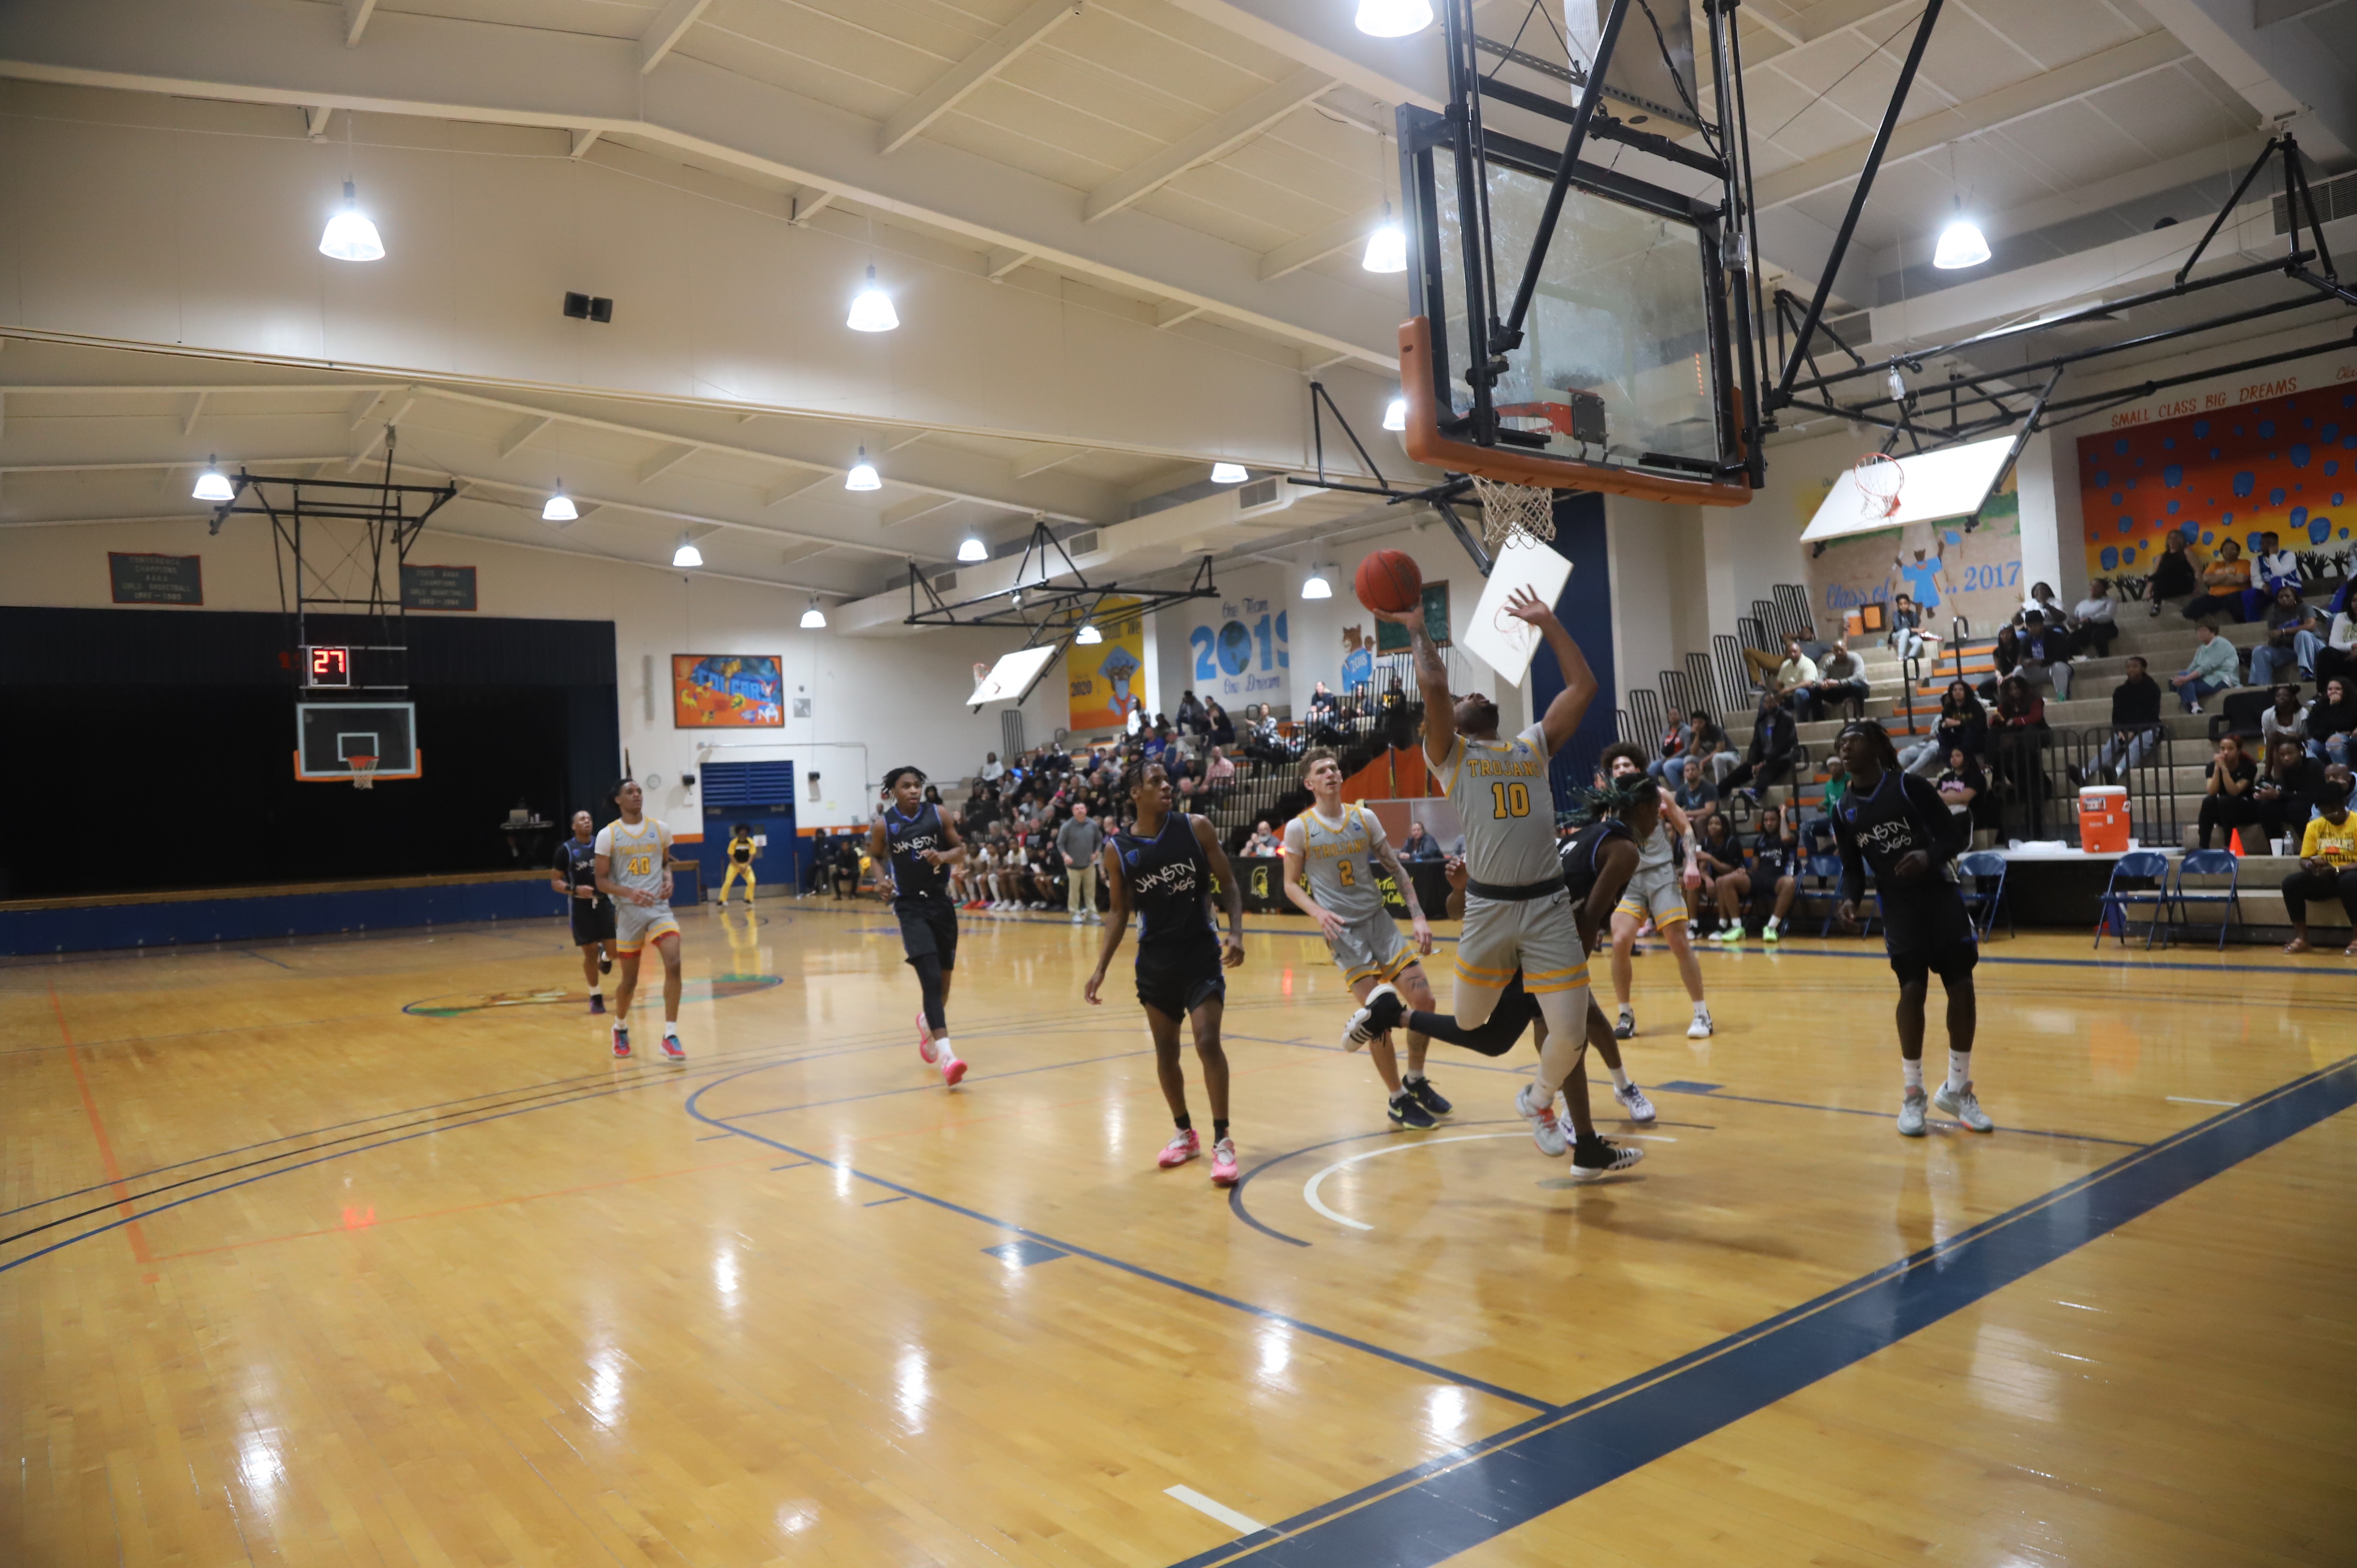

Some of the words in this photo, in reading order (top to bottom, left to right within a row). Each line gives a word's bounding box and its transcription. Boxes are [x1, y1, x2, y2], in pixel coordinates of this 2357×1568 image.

[2112, 408, 2150, 429] SMALL
[2159, 398, 2196, 419] CLASS
[2205, 393, 2226, 409] BIG
[2239, 377, 2298, 403] DREAMS
[1243, 598, 1269, 614] Team
[1827, 583, 1867, 610] Class
[313, 650, 345, 673] 27
[1350, 653, 1368, 673] 2018
[1224, 678, 1240, 695] One
[1246, 674, 1280, 692] Dream
[1467, 759, 1541, 778] TROJANS
[1491, 782, 1530, 820] 10
[1313, 837, 1368, 860] TROJANS
[628, 857, 650, 876] 40
[1338, 859, 1355, 887] 2
[1168, 876, 1195, 895] JAGS
